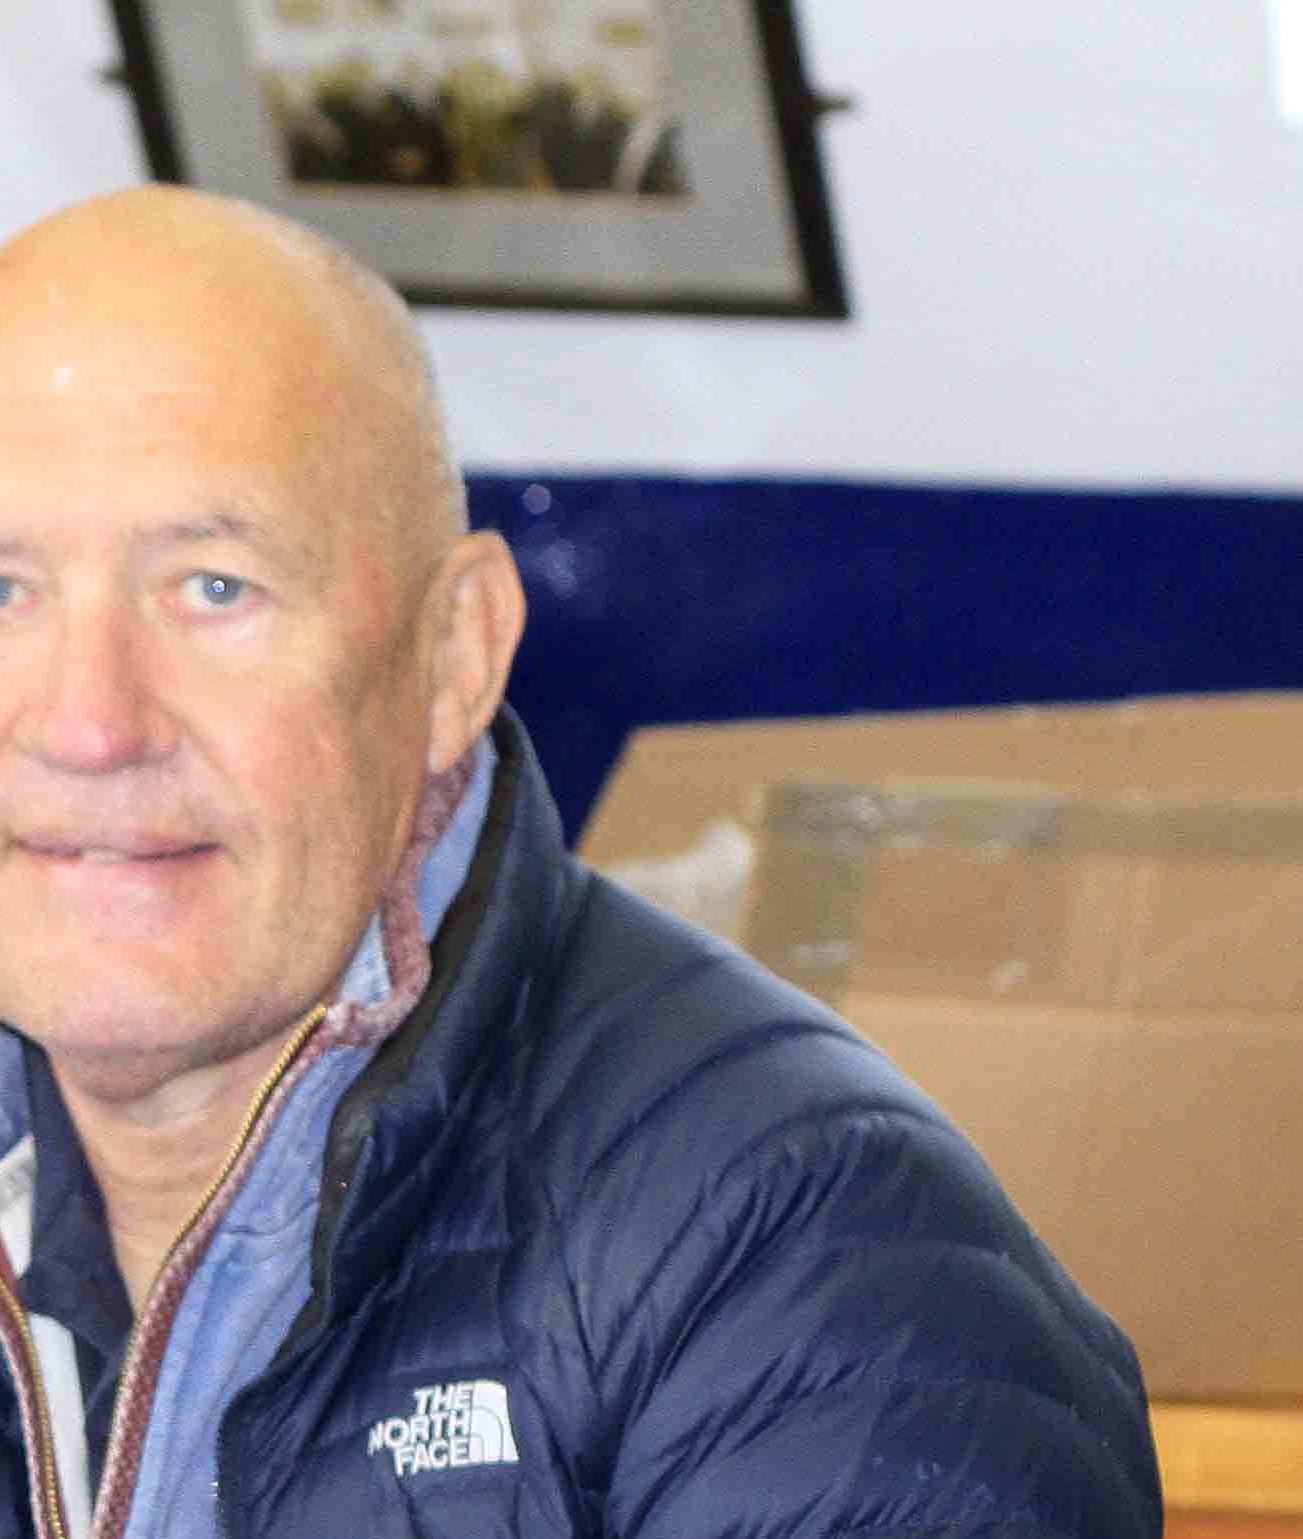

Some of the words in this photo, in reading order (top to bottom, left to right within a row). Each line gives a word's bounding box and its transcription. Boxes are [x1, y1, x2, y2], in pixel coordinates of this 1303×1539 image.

[413, 1382, 473, 1415] THE
[367, 1410, 470, 1456] NORTH
[394, 1437, 469, 1476] FACE
